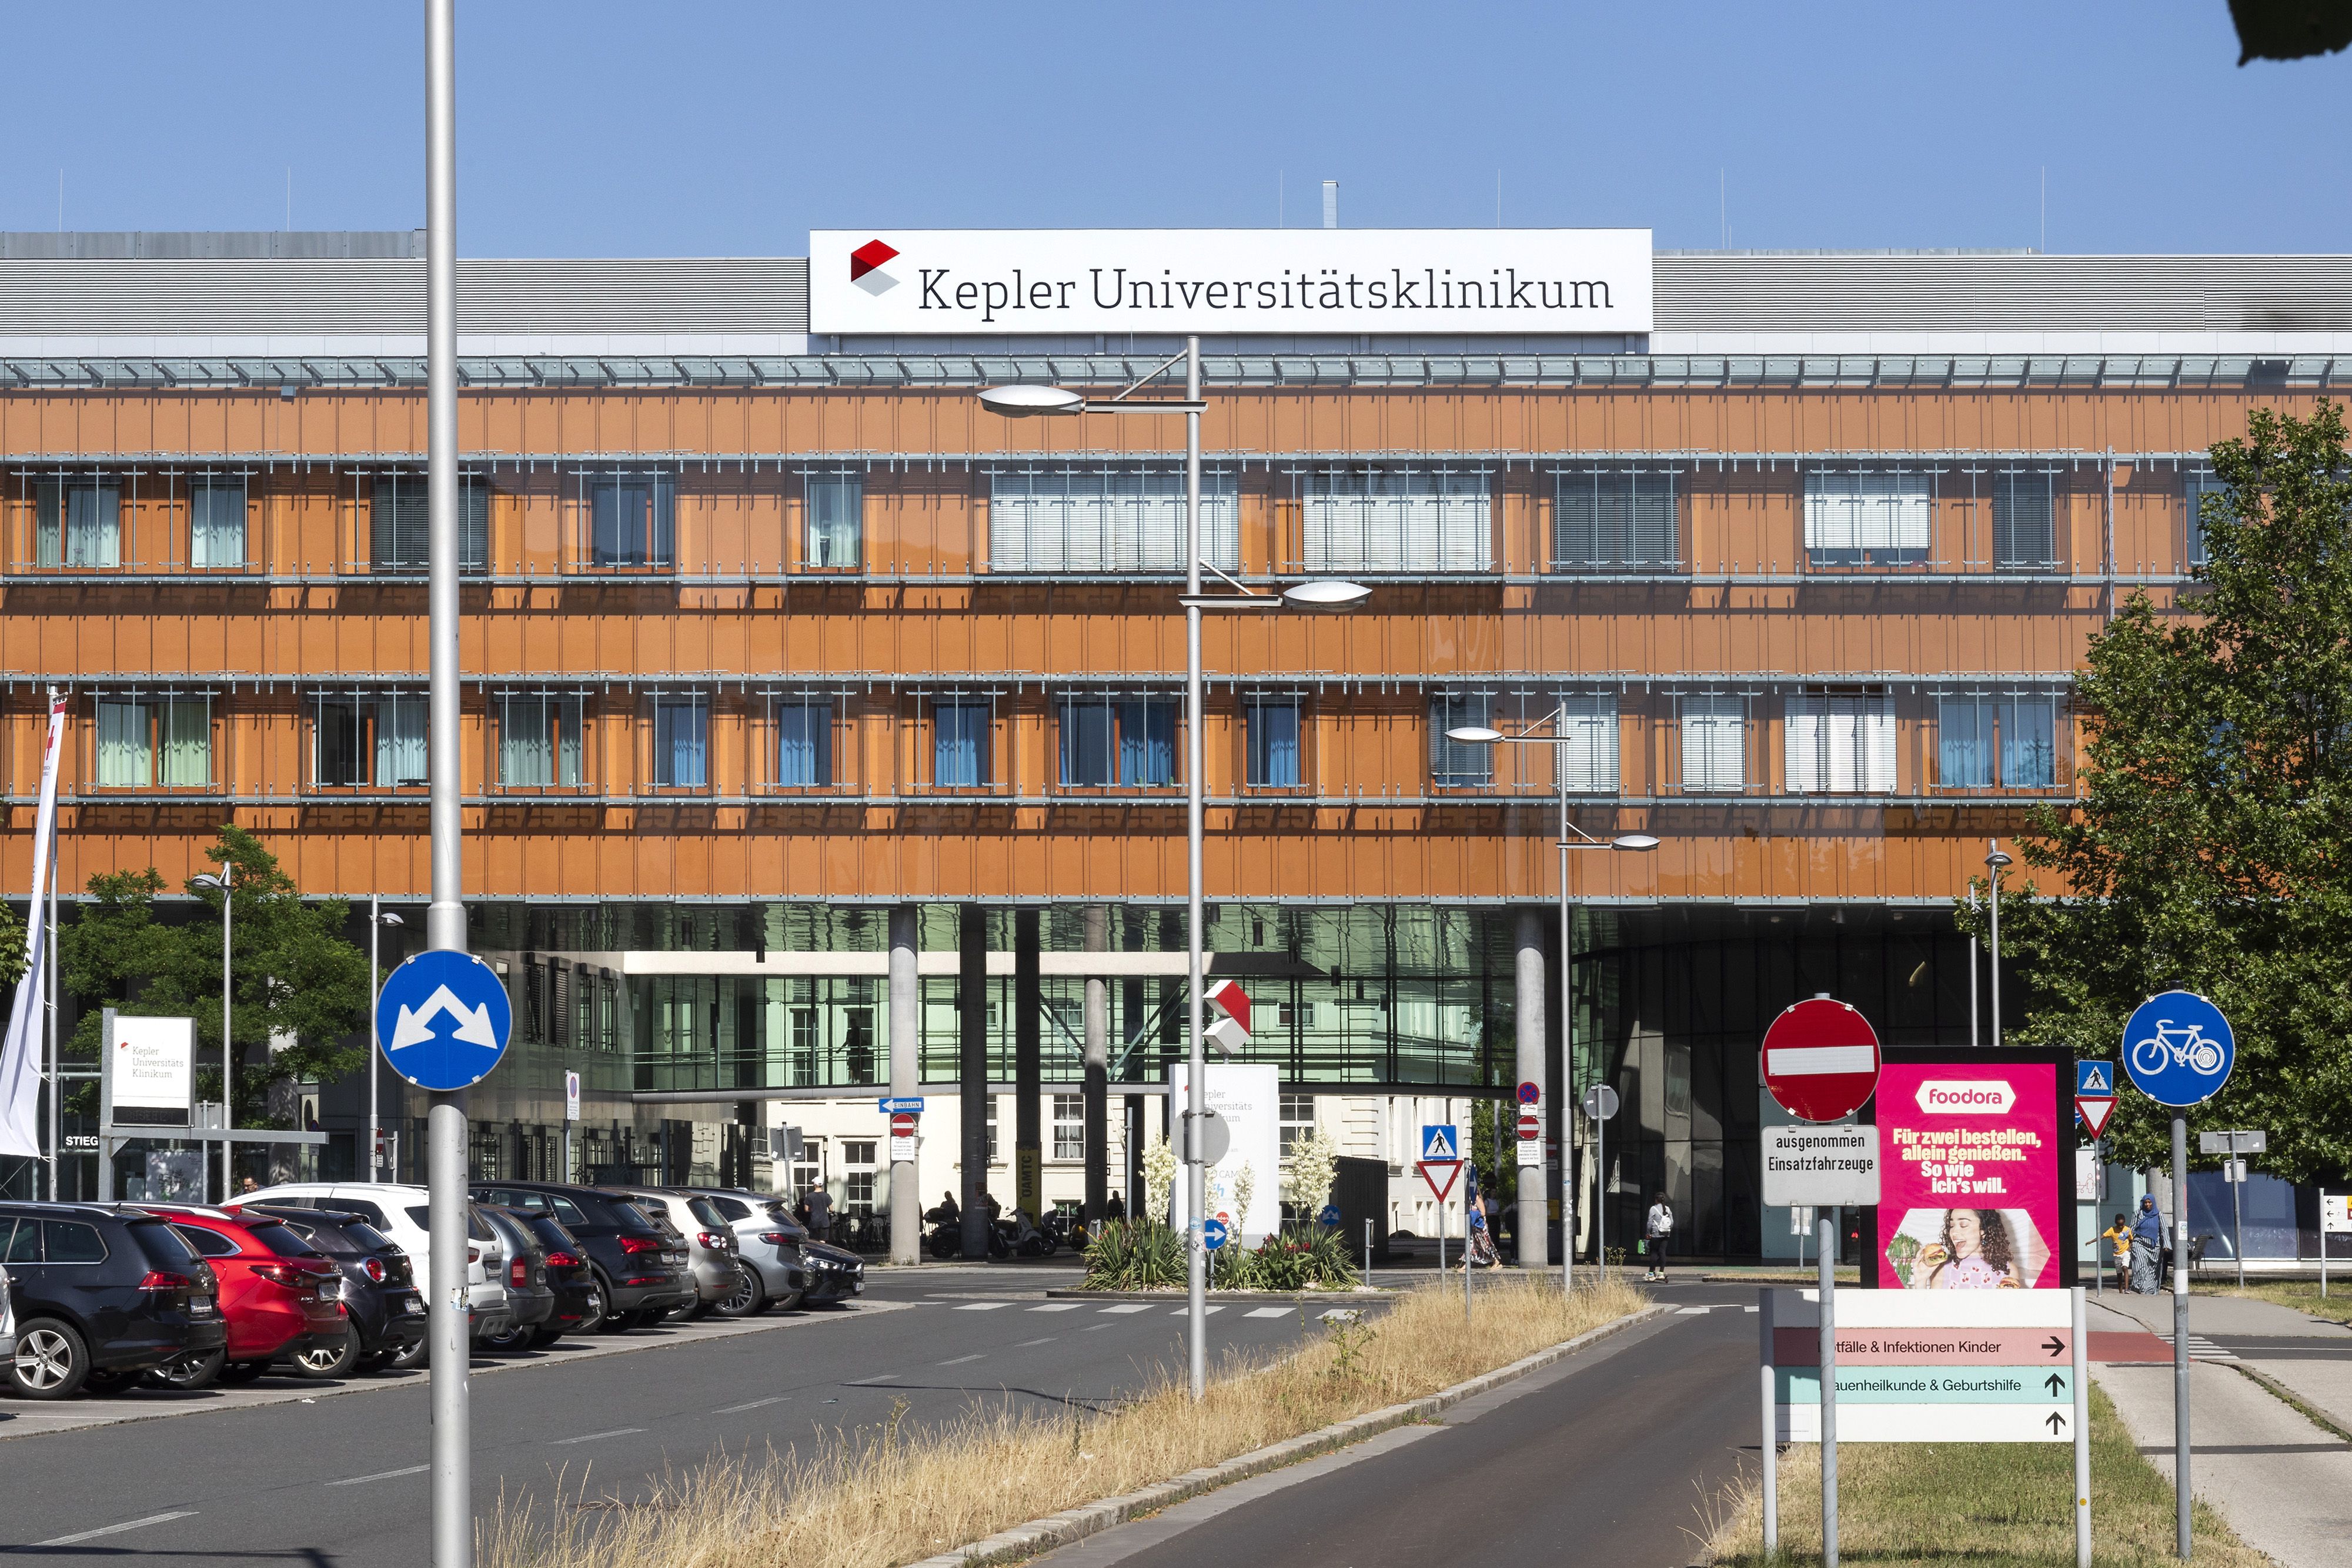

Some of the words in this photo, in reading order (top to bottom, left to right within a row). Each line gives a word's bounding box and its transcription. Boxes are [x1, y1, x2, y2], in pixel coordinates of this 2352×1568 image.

[918, 269, 1075, 322] Kepler
[1089, 268, 1614, 309] Universitätsklinikum
[132, 1047, 159, 1057] Kepler
[132, 1058, 184, 1067] Universitäts
[132, 1068, 172, 1078] Klinikum
[1204, 1089, 1225, 1100] epler
[1929, 1088, 2002, 1104] foodora
[1204, 1101, 1252, 1111] niversitäts
[1776, 1136, 1865, 1152] ausgenommen
[1893, 1128, 1920, 1144] Für
[1921, 1128, 1960, 1145] zwei
[1961, 1128, 2042, 1148] bestellen,
[1902, 1145, 1946, 1161] allein
[1947, 1145, 2027, 1164] genießen.
[1769, 1156, 1873, 1174] Einsatzfahrzeuge
[1921, 1161, 1943, 1177] So
[1944, 1161, 1975, 1177] wie
[1972, 1177, 2007, 1193] will.
[1818, 1340, 1867, 1353] tfälle
[1870, 1340, 1880, 1353] &
[1883, 1340, 1955, 1353] Infektionen
[1959, 1340, 2002, 1353] Kinder
[1834, 1379, 1926, 1391] auenheilkunde
[1930, 1379, 1939, 1391] &
[1943, 1379, 2022, 1391] Geburtshilfe
